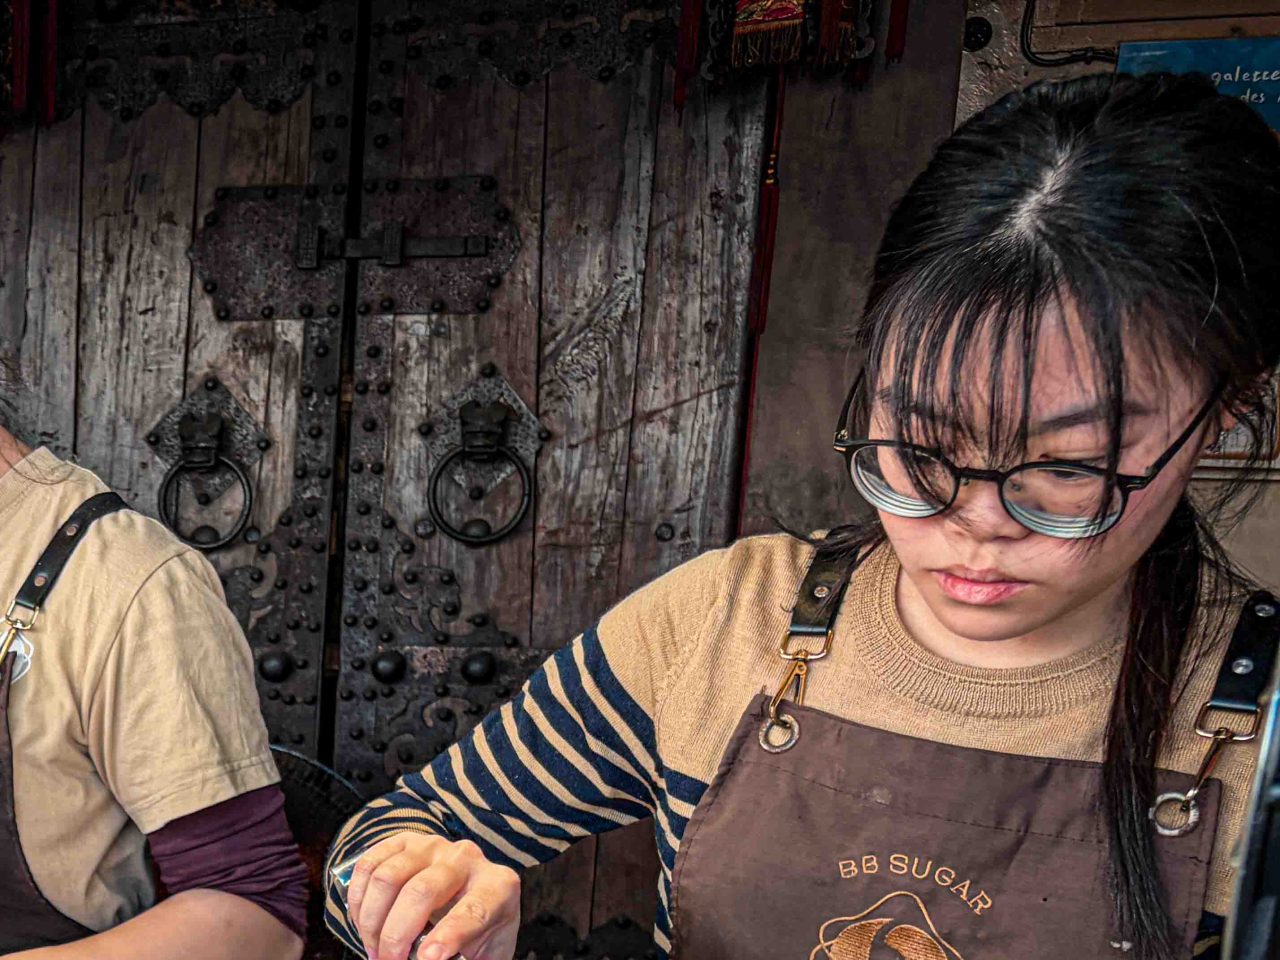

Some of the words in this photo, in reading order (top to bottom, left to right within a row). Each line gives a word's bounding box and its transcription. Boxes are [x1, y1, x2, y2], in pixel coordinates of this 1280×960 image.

[1240, 87, 1266, 104] des
[838, 855, 879, 879] BB
[889, 853, 993, 916] SUGAR
